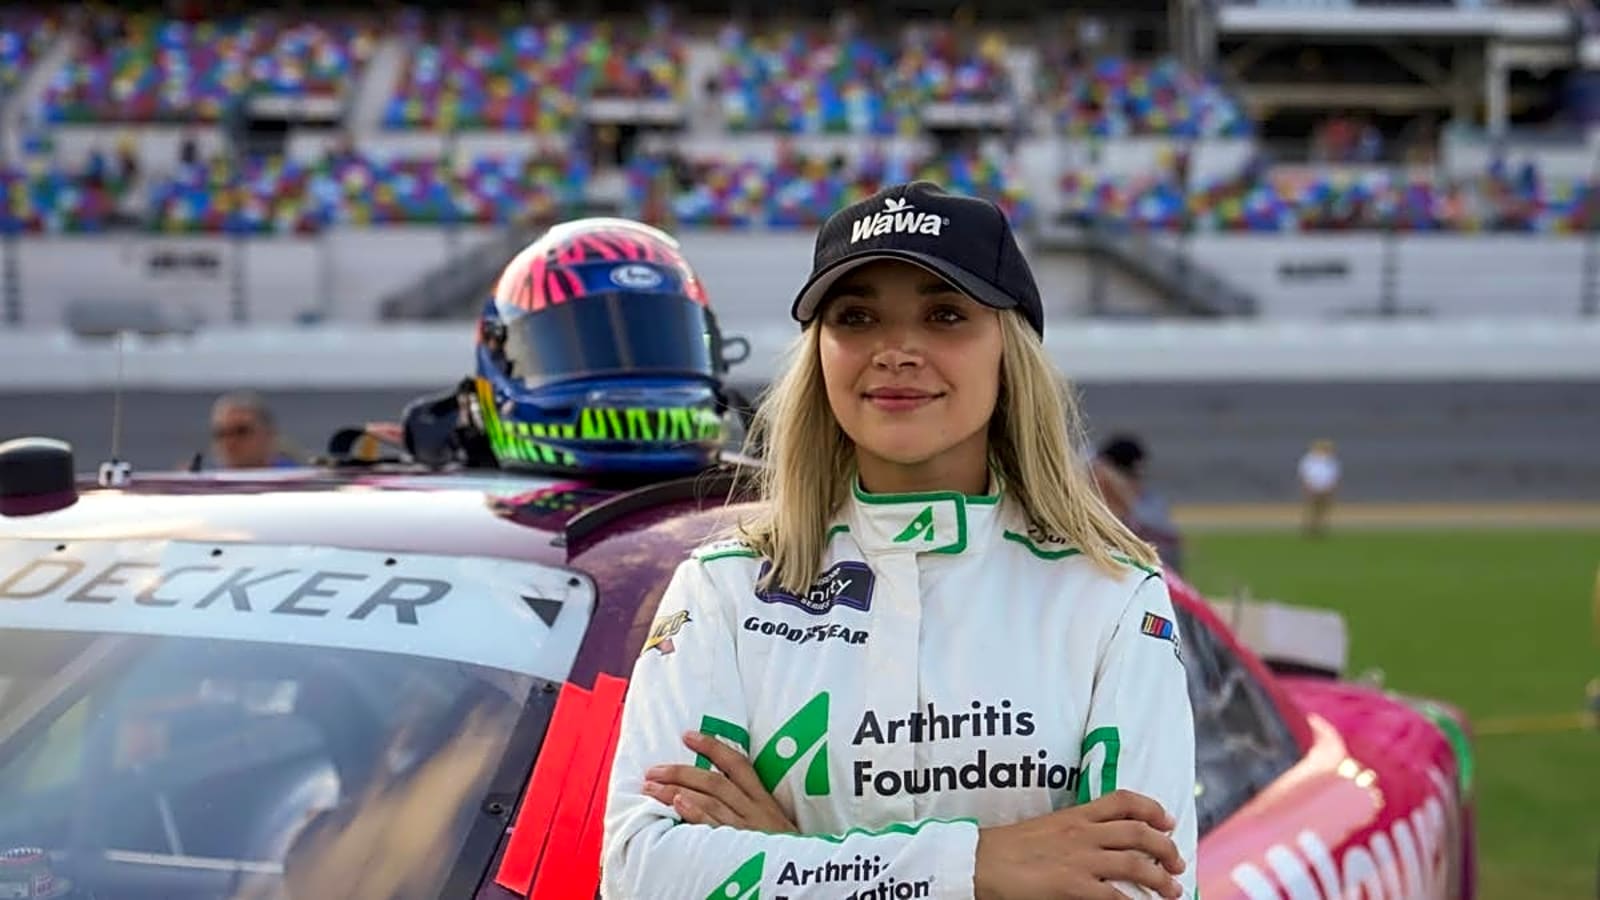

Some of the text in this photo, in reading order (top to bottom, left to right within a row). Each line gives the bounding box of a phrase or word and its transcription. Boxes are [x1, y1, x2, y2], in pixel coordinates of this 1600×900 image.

[1, 558, 453, 626] DECKER
[743, 617, 869, 645] GOODYEAR
[851, 699, 1036, 746] Arthritis
[853, 749, 1080, 797] Foundation
[776, 855, 890, 886] Arthriti
